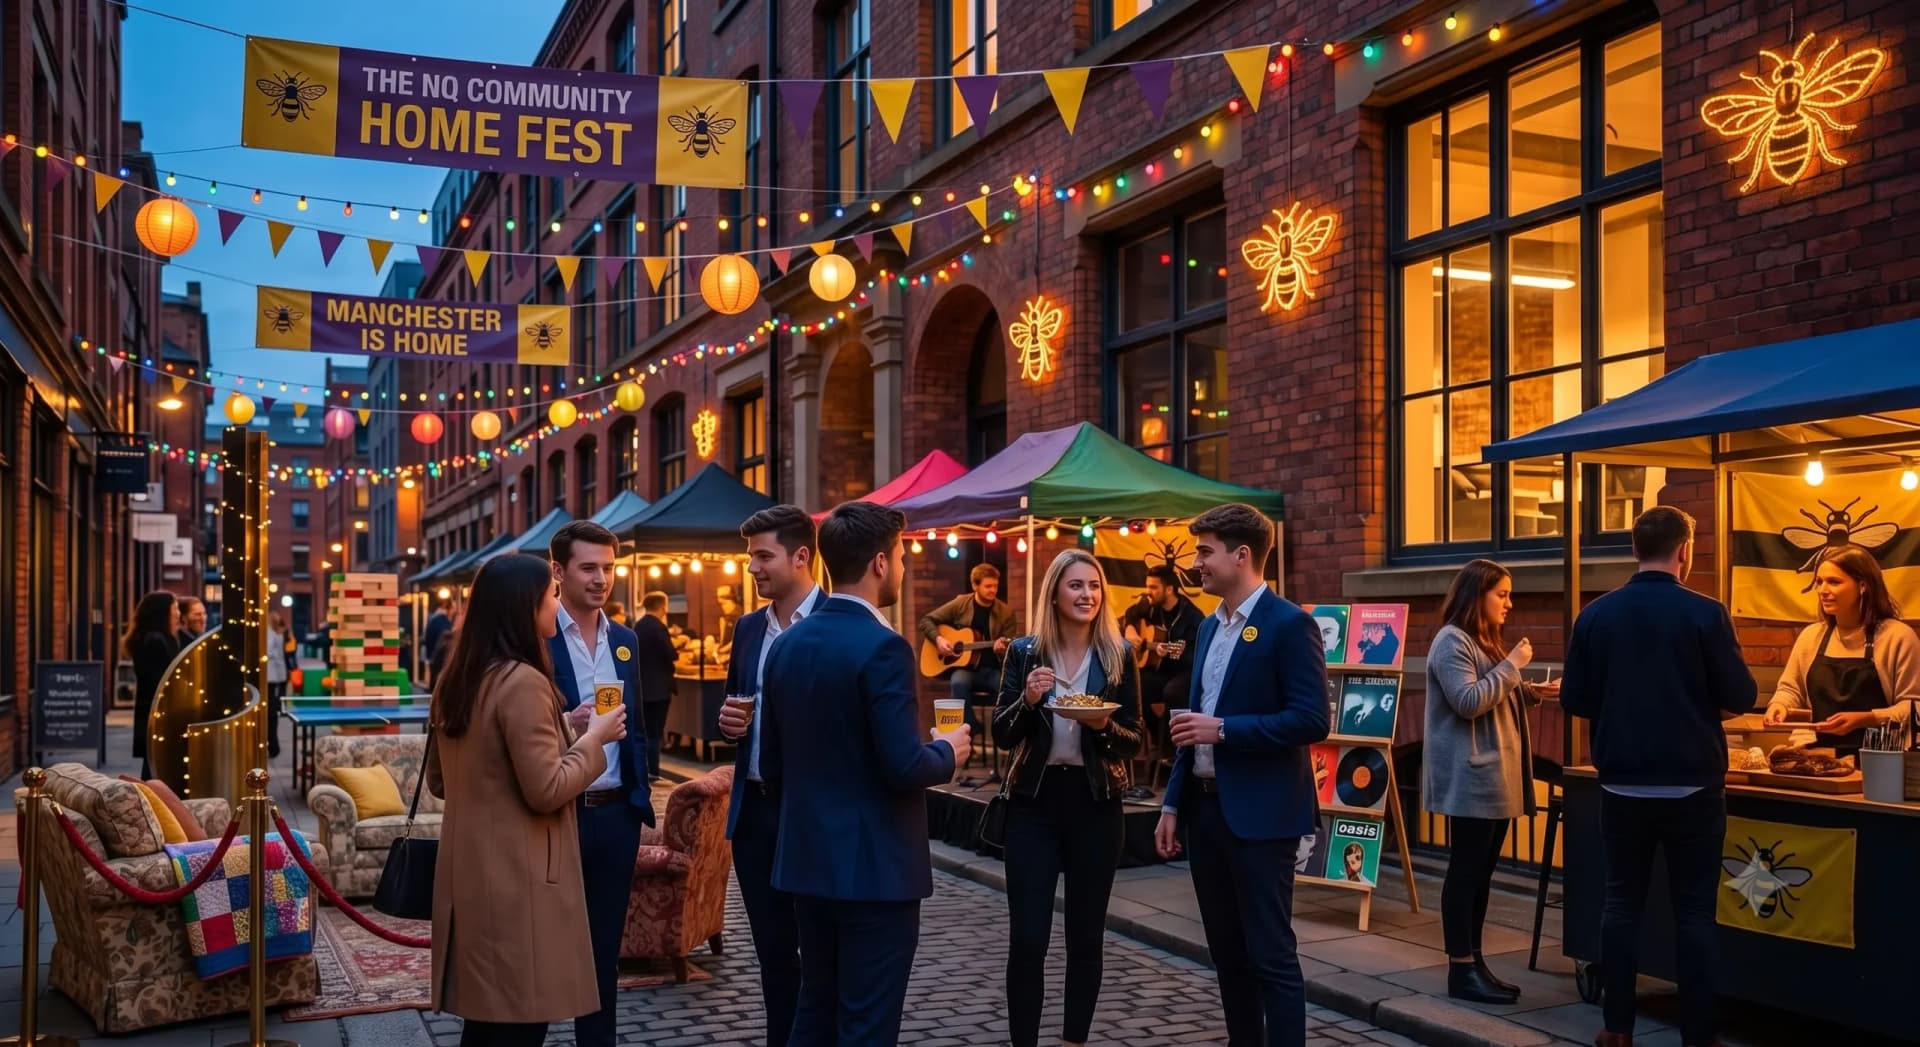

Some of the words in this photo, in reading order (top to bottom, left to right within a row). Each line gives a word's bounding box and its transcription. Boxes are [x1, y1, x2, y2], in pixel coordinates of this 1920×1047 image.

[362, 67, 414, 95] THE
[422, 73, 459, 102] NQ
[467, 78, 632, 114] COMMUNITY
[360, 101, 501, 155] HOME
[517, 115, 632, 165] FEST
[327, 299, 502, 331] MANCHESTER
[361, 328, 385, 350] IS
[394, 330, 468, 356] HOME
[1338, 824, 1377, 837] oasis
